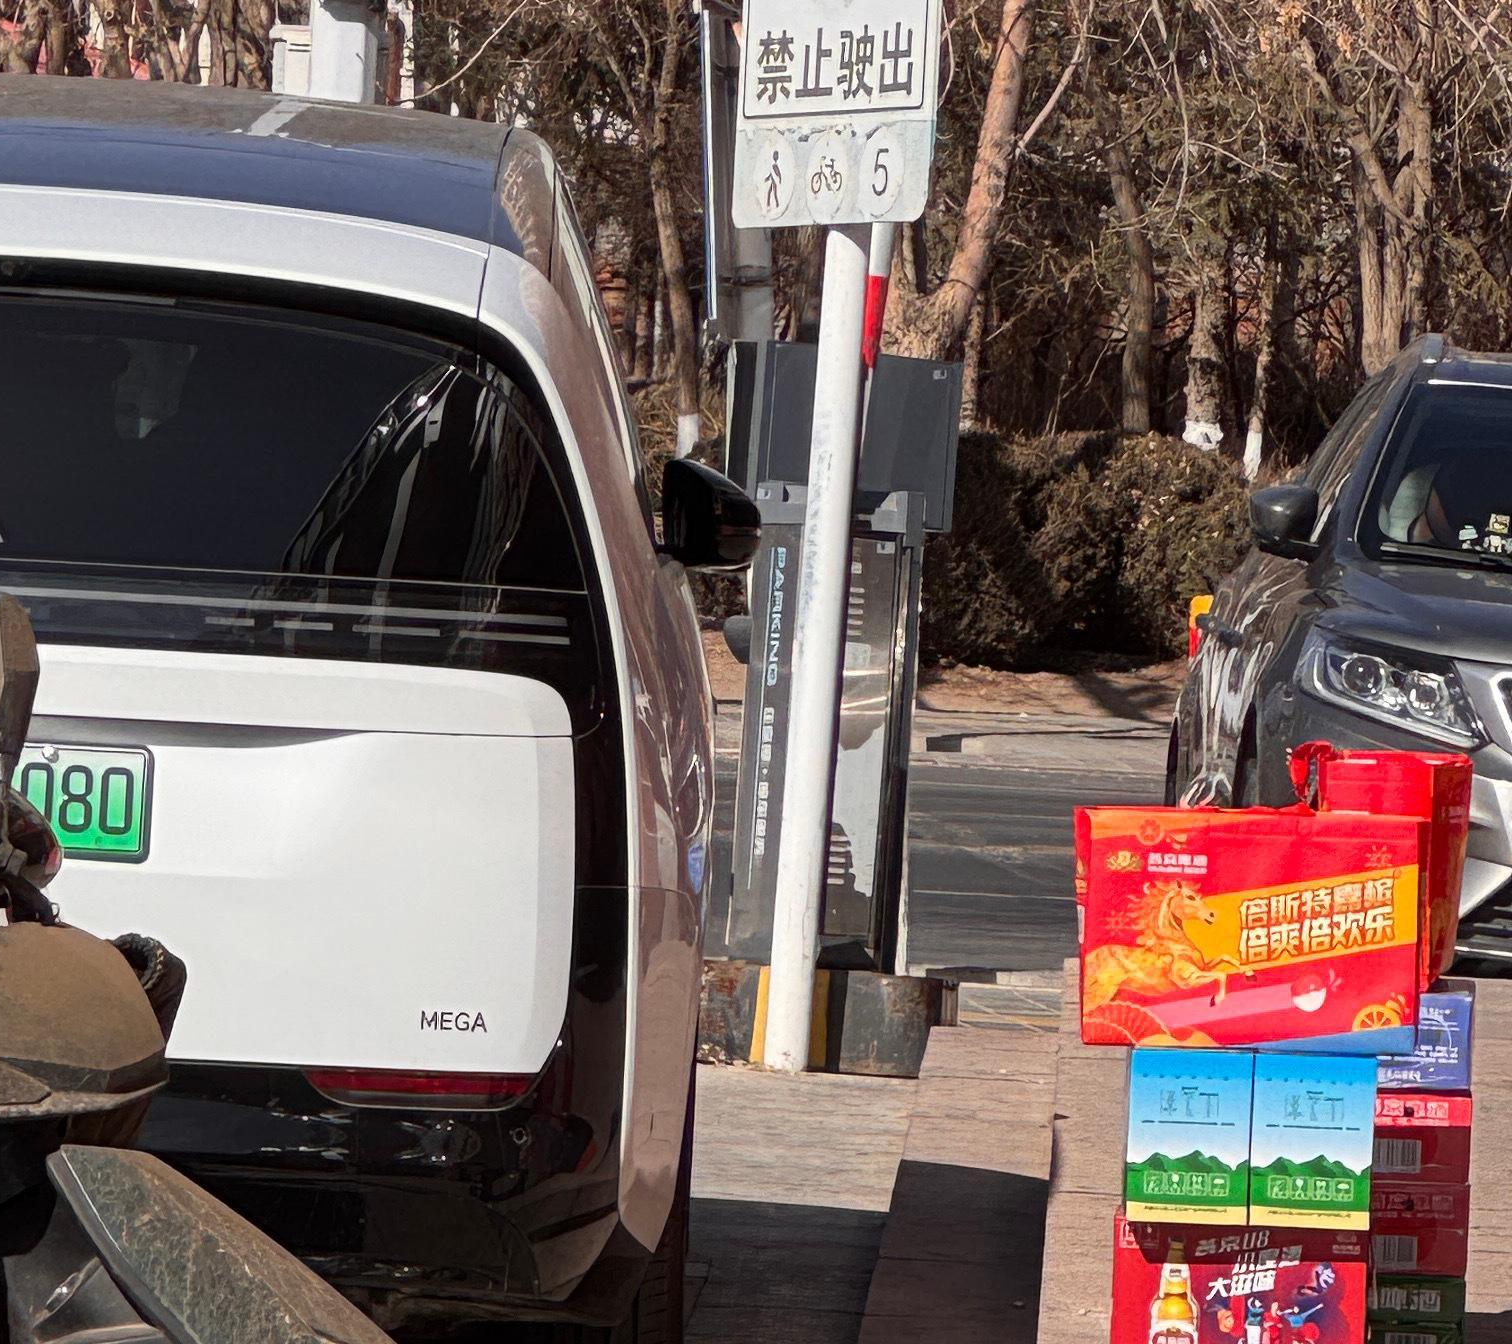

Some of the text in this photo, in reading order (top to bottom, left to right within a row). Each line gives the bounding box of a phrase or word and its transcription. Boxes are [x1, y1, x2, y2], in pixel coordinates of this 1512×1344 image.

[756, 22, 913, 104] 禁止驶出
[872, 148, 889, 196] 5
[1239, 906, 1395, 962] 倍爽倍欢乐
[420, 1010, 487, 1033] MEGA
